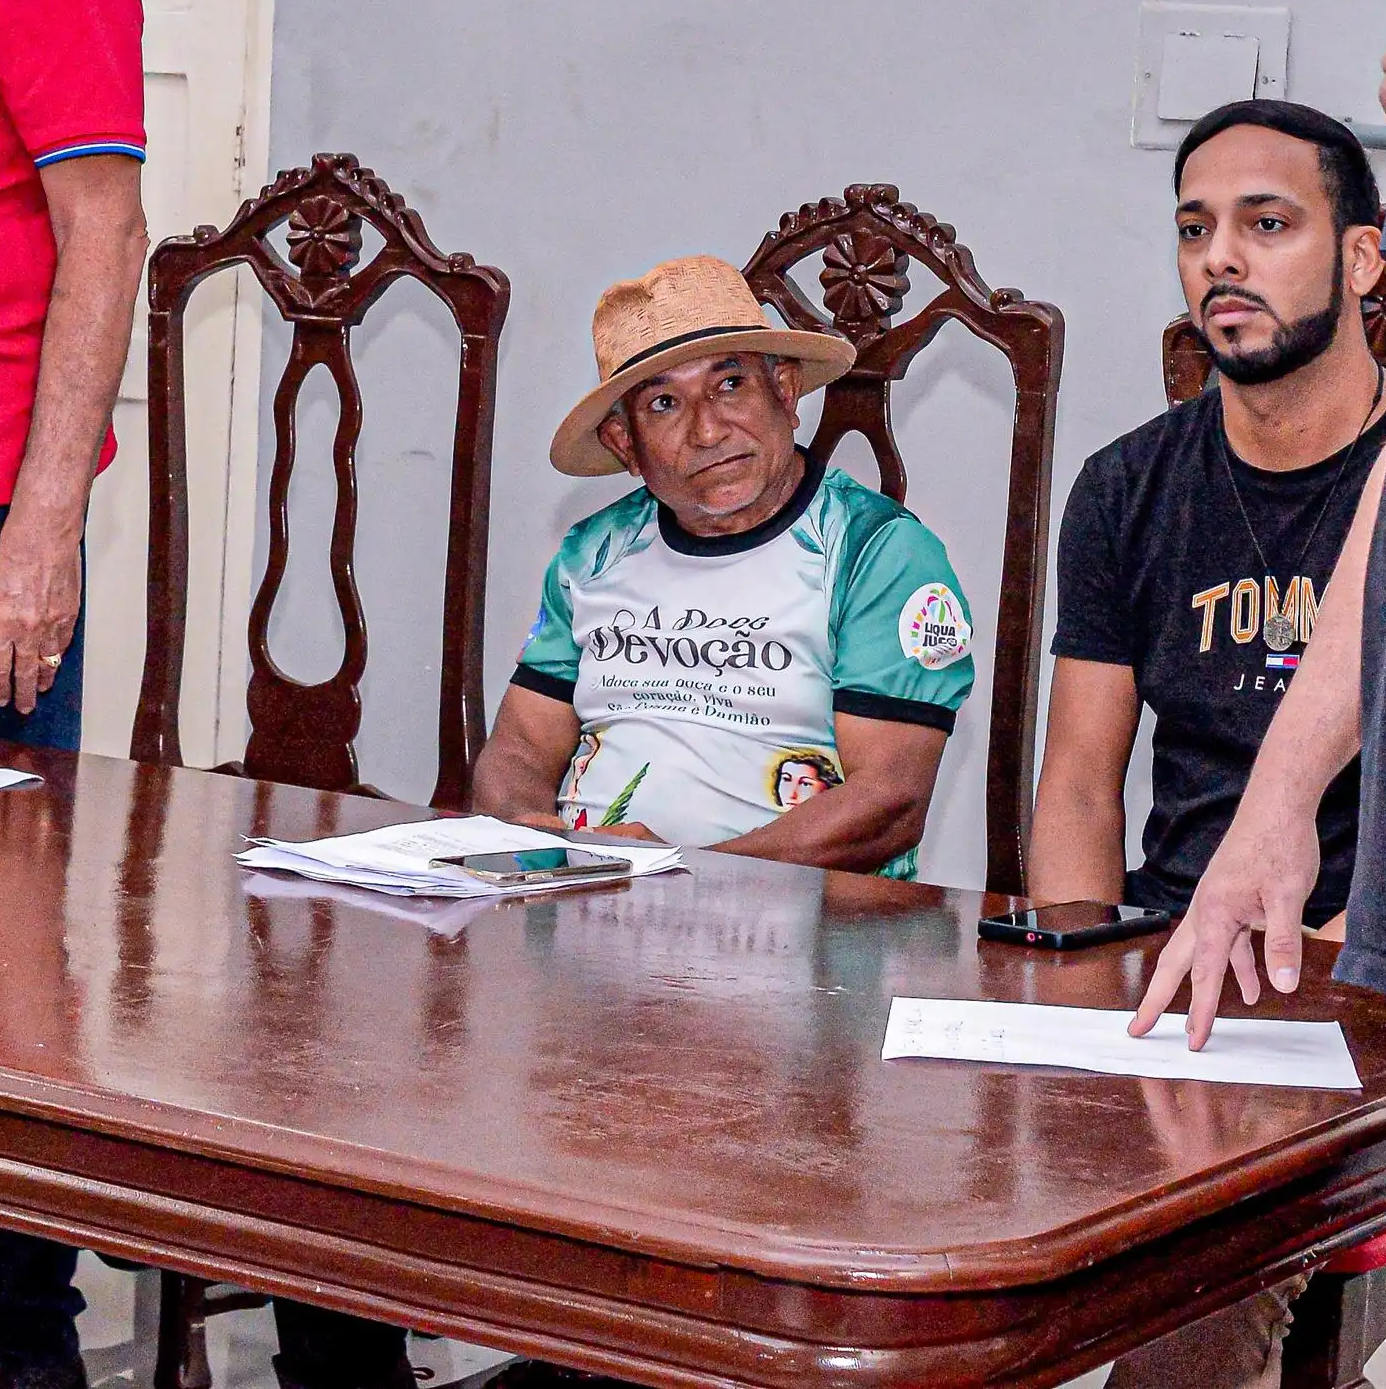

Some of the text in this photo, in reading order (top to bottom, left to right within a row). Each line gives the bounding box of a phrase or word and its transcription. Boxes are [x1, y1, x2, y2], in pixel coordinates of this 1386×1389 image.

[1191, 575, 1330, 653] TOMM
[588, 609, 793, 677] Devoção
[732, 685, 742, 695] o
[747, 686, 776, 697] seu
[1233, 673, 1286, 692] JEA
